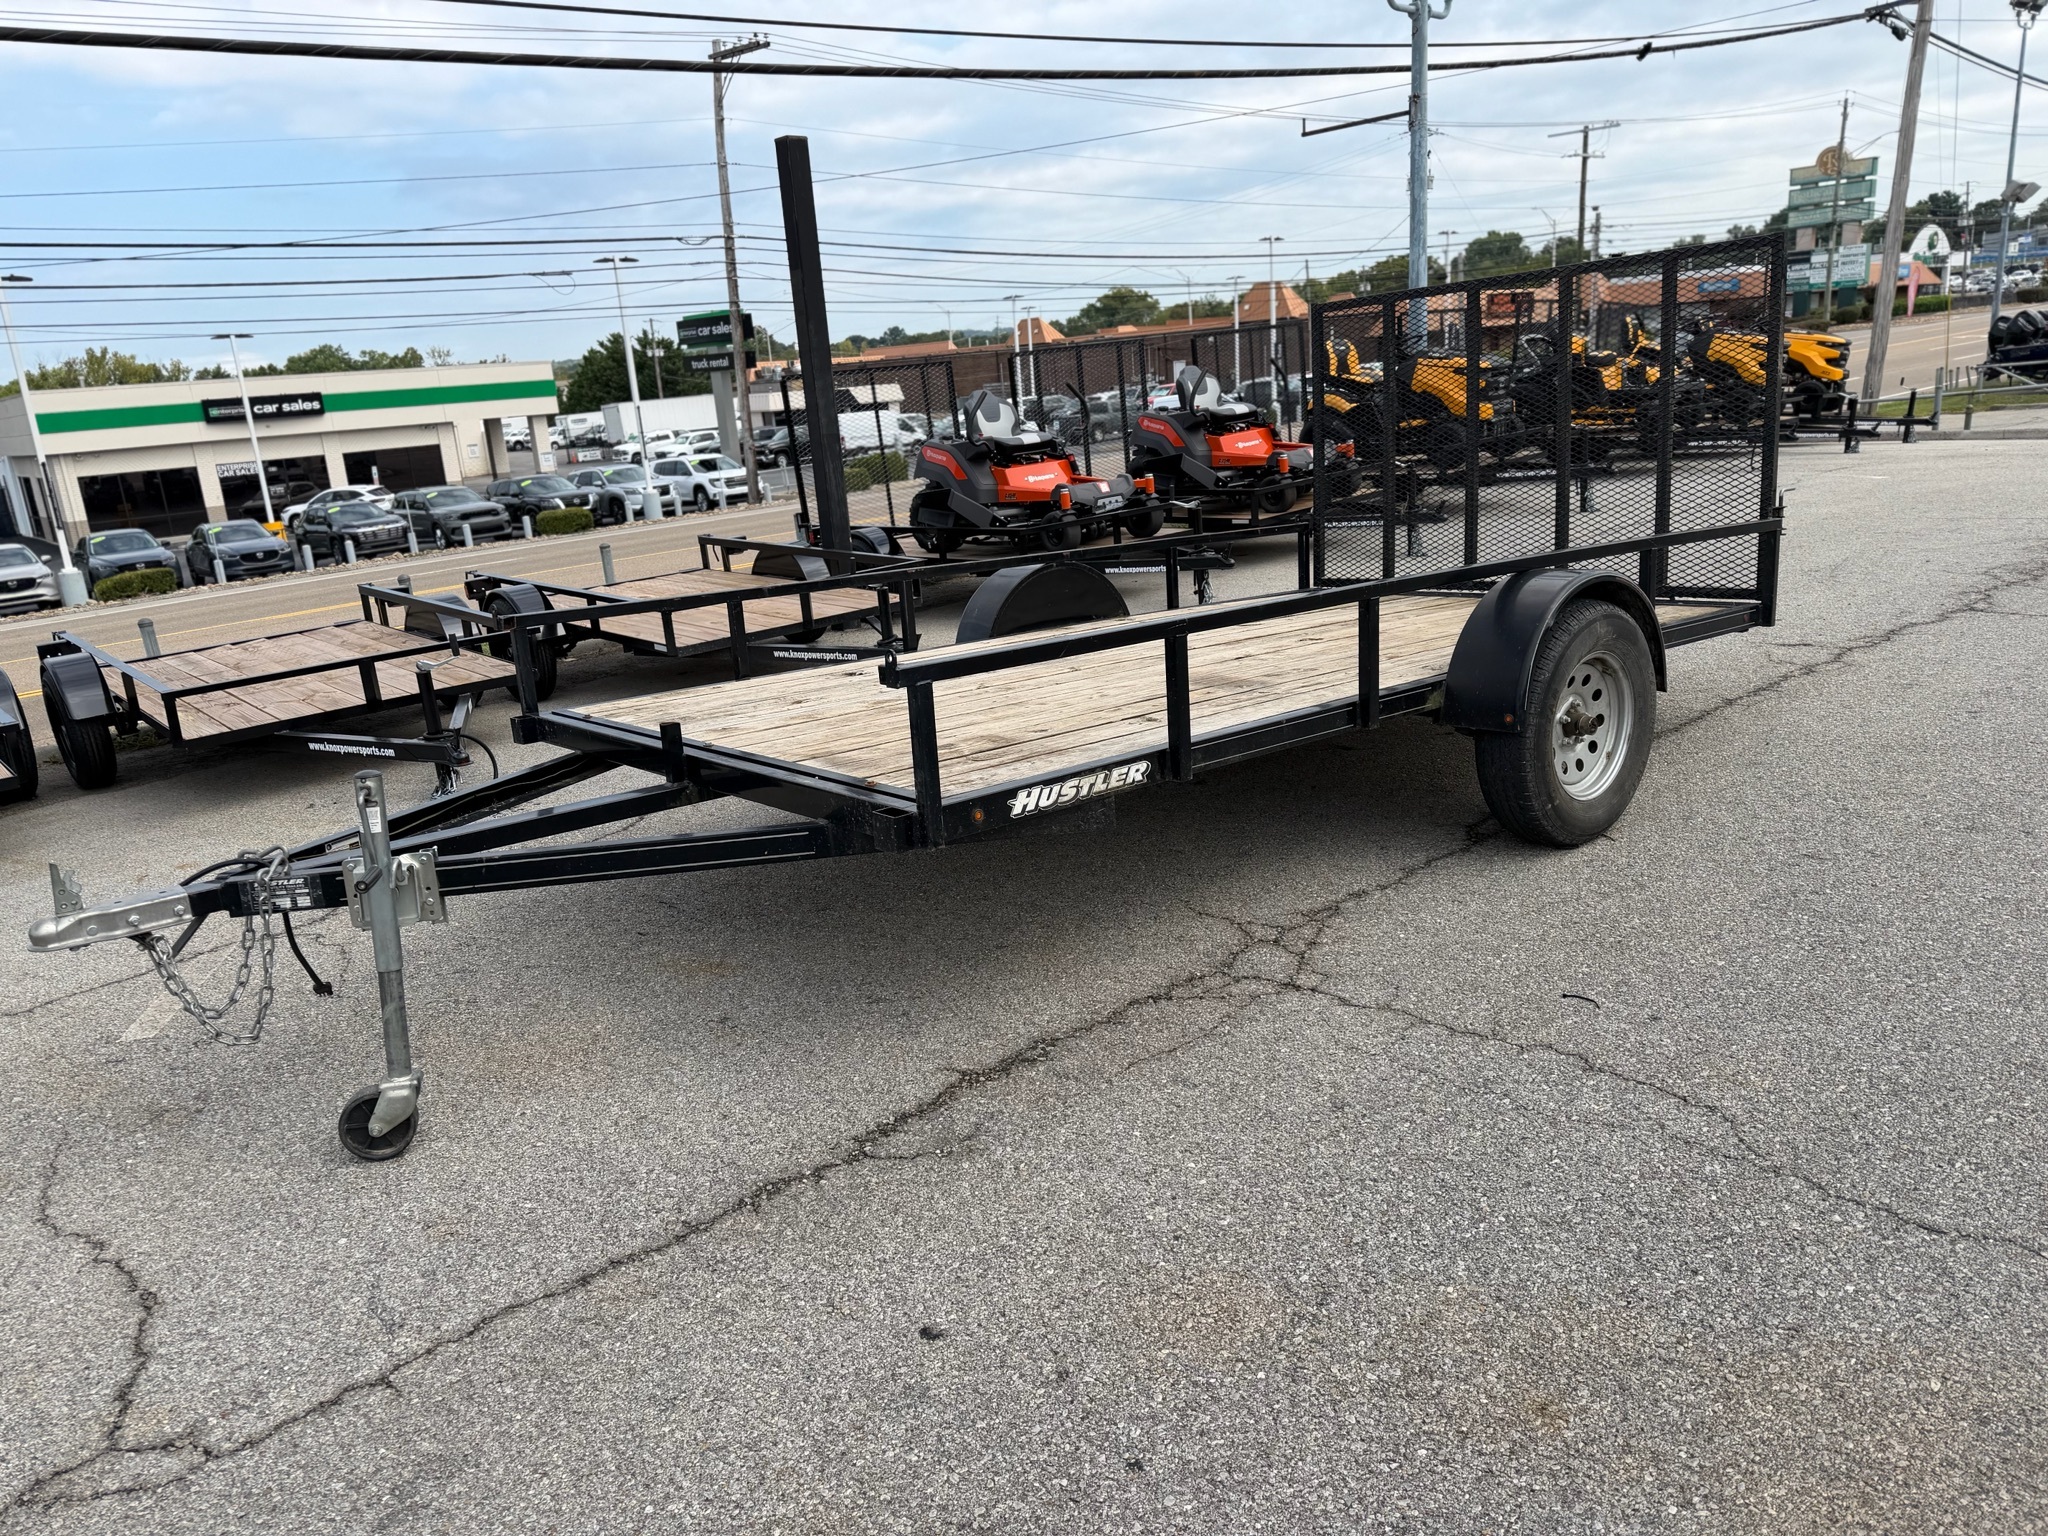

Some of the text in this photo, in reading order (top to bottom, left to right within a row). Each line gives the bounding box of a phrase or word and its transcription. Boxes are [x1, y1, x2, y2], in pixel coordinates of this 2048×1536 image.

[697, 326, 711, 336] car
[691, 356, 729, 369] truck rental
[209, 398, 321, 417] enterpris car sales
[218, 470, 235, 478] CAR
[773, 650, 858, 661] www.knoxpowersports.com
[307, 741, 396, 757] www.knoxpowersports.com
[1008, 762, 1151, 818] HUSTLER
